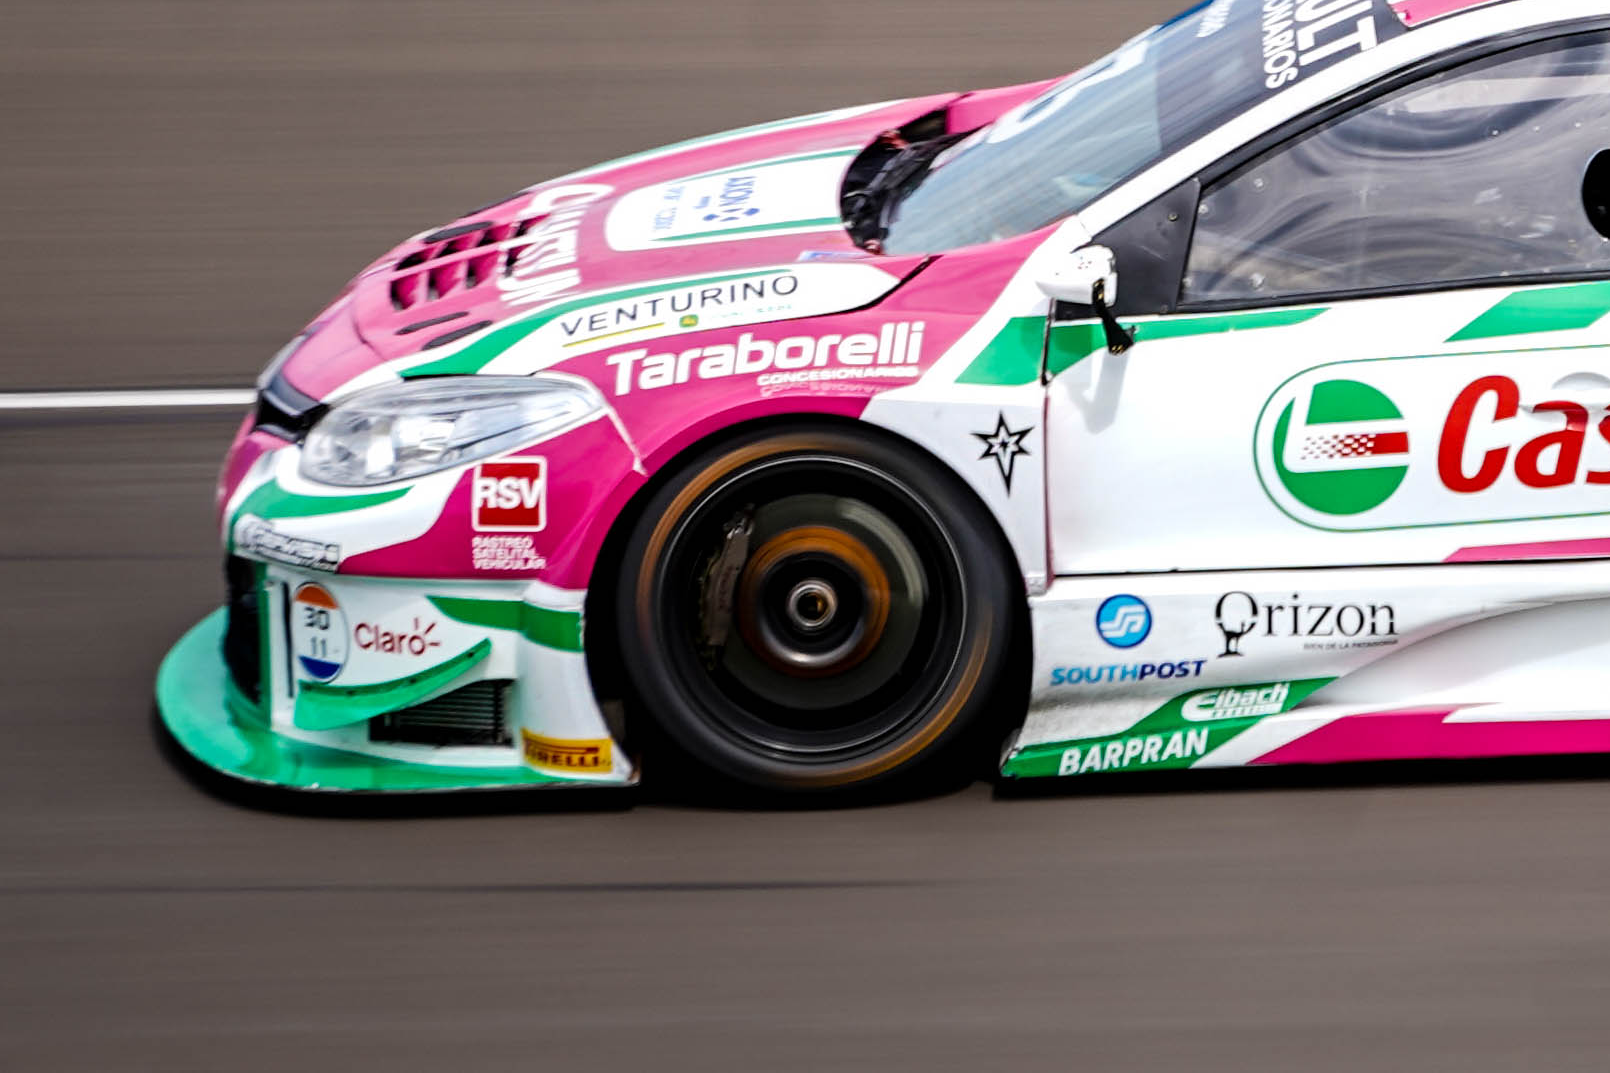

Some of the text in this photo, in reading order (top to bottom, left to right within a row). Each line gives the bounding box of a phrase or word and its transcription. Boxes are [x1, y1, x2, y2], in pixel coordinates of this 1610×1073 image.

[560, 274, 799, 337] VENTURINO
[606, 321, 925, 397] Taraborelli
[474, 476, 541, 510] RSV
[472, 535, 534, 549] RASTREO
[472, 547, 540, 560] SATELITAL
[473, 558, 547, 571] VEHICULAR
[354, 623, 426, 656] Claro
[1050, 659, 1208, 686] SOUTHPOST
[1058, 728, 1209, 776] BARPRAN
